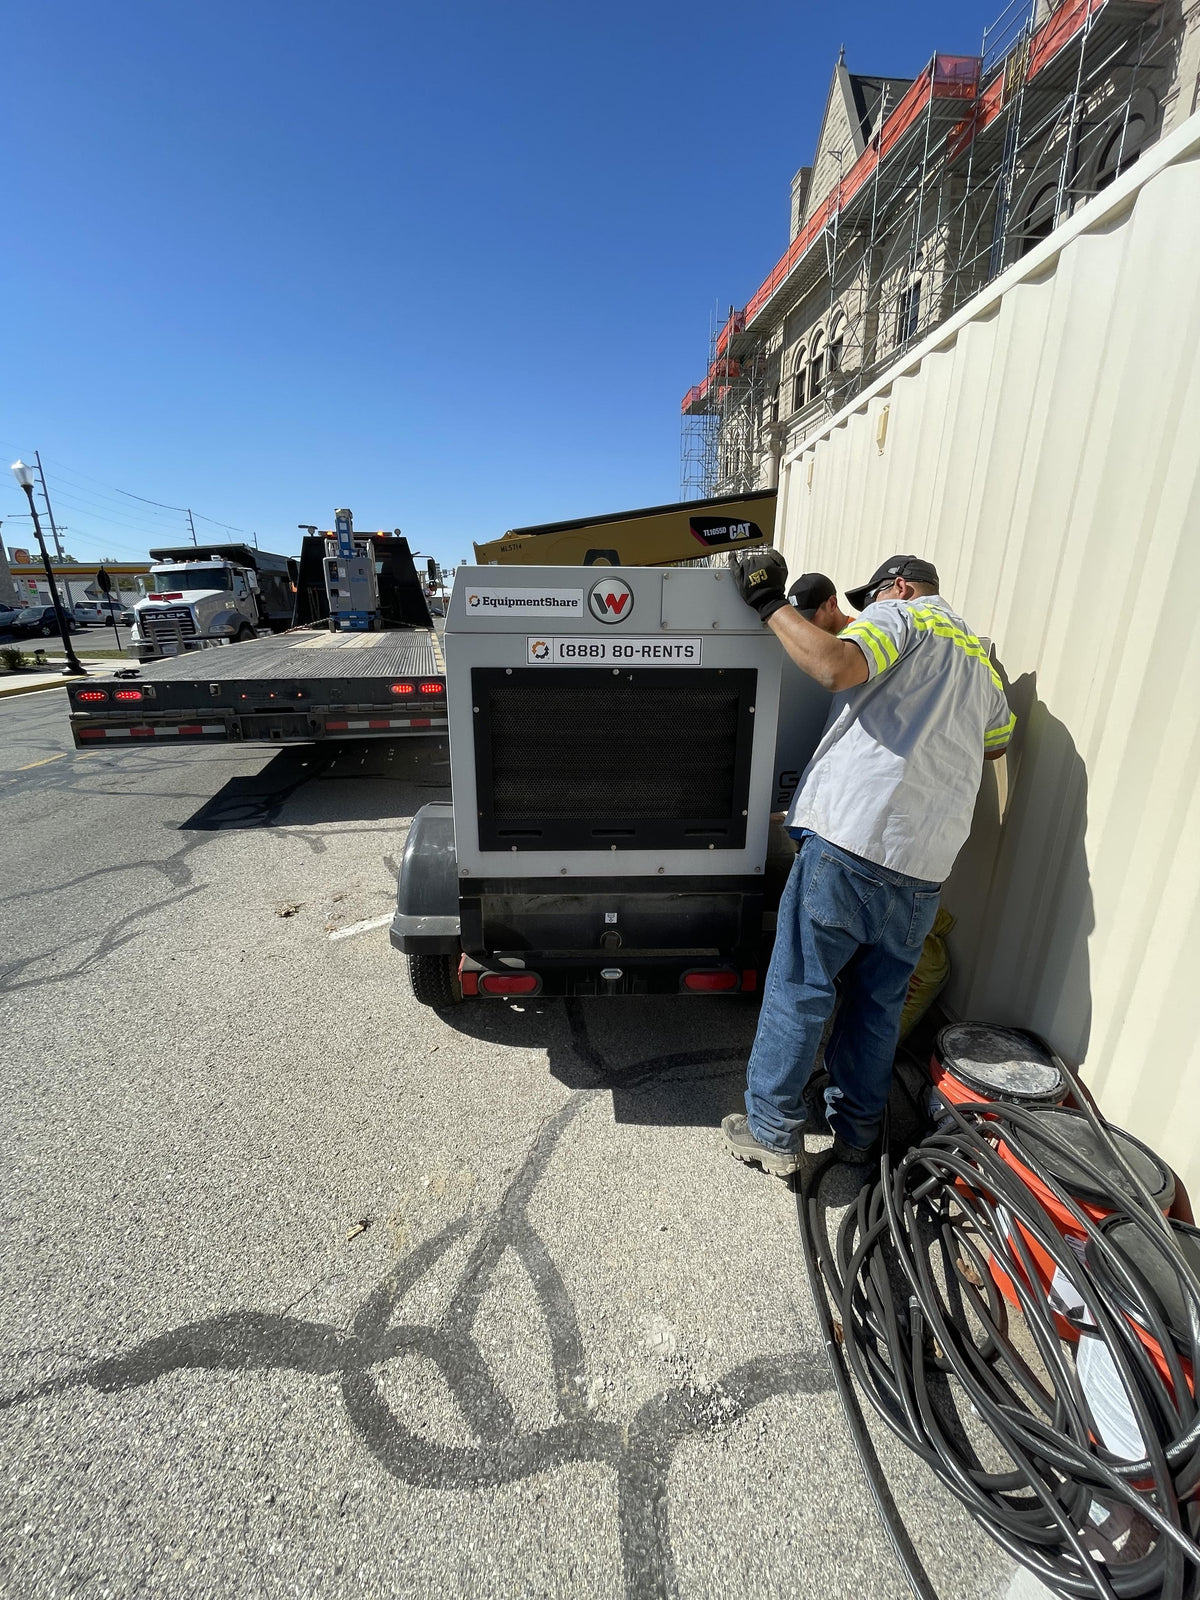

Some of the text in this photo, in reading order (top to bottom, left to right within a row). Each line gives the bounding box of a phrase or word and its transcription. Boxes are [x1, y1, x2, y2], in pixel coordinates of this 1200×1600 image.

[703, 522, 751, 540] TL1055D CAT
[748, 568, 768, 587] CAT
[482, 596, 578, 608] EquipmentShare
[560, 643, 695, 659] (888) 80-RENTS
